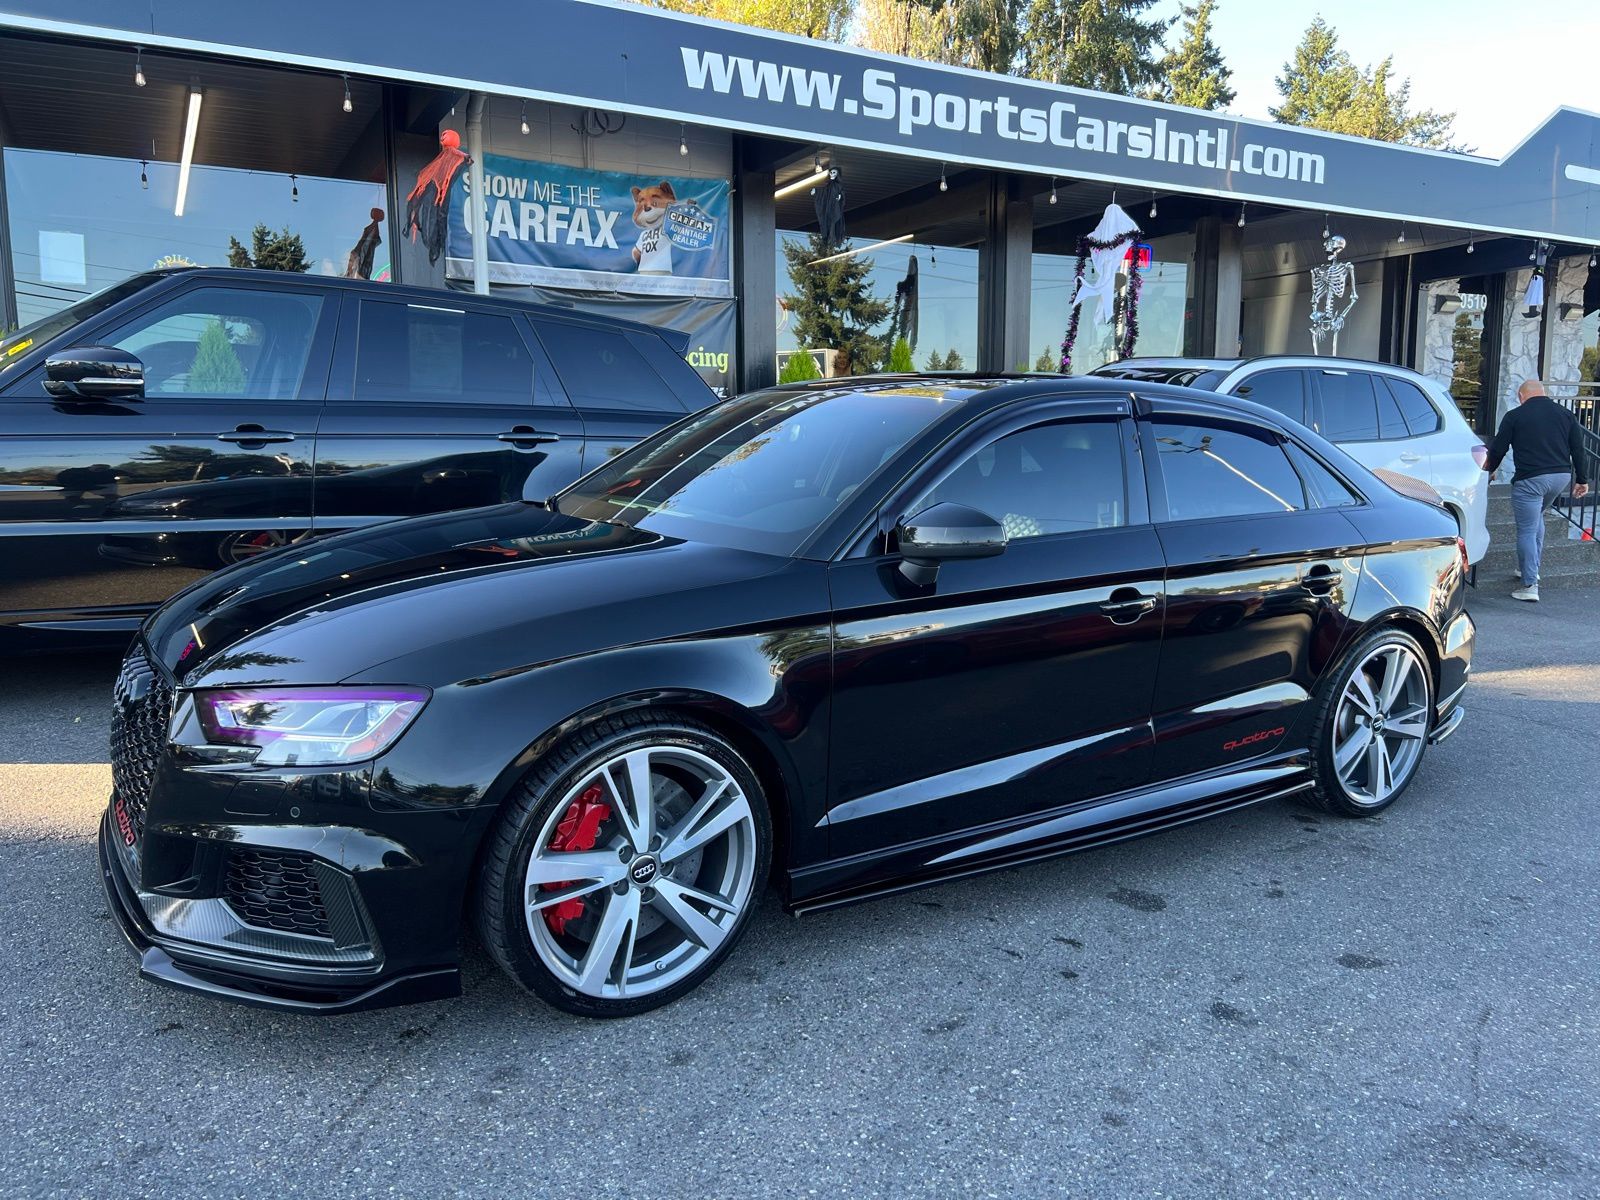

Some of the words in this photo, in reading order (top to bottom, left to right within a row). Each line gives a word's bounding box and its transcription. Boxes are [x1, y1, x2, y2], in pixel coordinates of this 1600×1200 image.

[680, 46, 1326, 185] www.SportsCarsIntl.com
[463, 171, 528, 200] SHOW
[533, 180, 561, 204] ME
[565, 185, 601, 208] THE
[669, 223, 708, 242] ADVANTAGE
[670, 211, 713, 233] CARFAX
[641, 228, 660, 243] CAR
[672, 234, 699, 248] DEALER
[686, 346, 729, 374] cing
[1223, 727, 1285, 750] quattro
